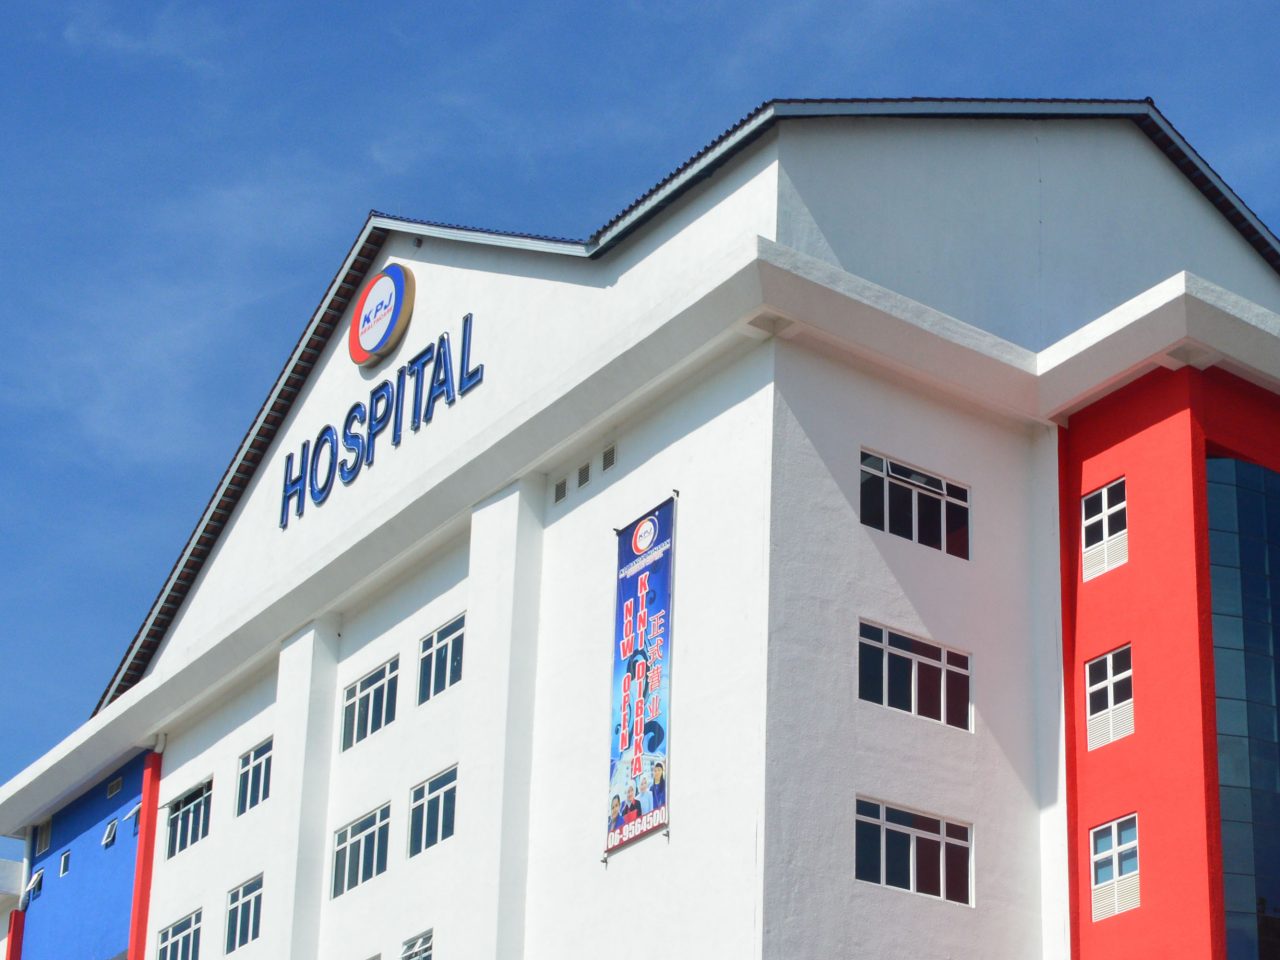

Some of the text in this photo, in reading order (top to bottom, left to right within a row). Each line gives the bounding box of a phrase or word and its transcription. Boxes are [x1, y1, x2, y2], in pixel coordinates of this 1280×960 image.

[362, 292, 393, 329] KPJ
[279, 312, 484, 531] HOSPITAL
[620, 598, 634, 660] NOW
[637, 571, 650, 651] KINI
[619, 672, 632, 752] OPEN
[631, 659, 646, 778] DIBUKA
